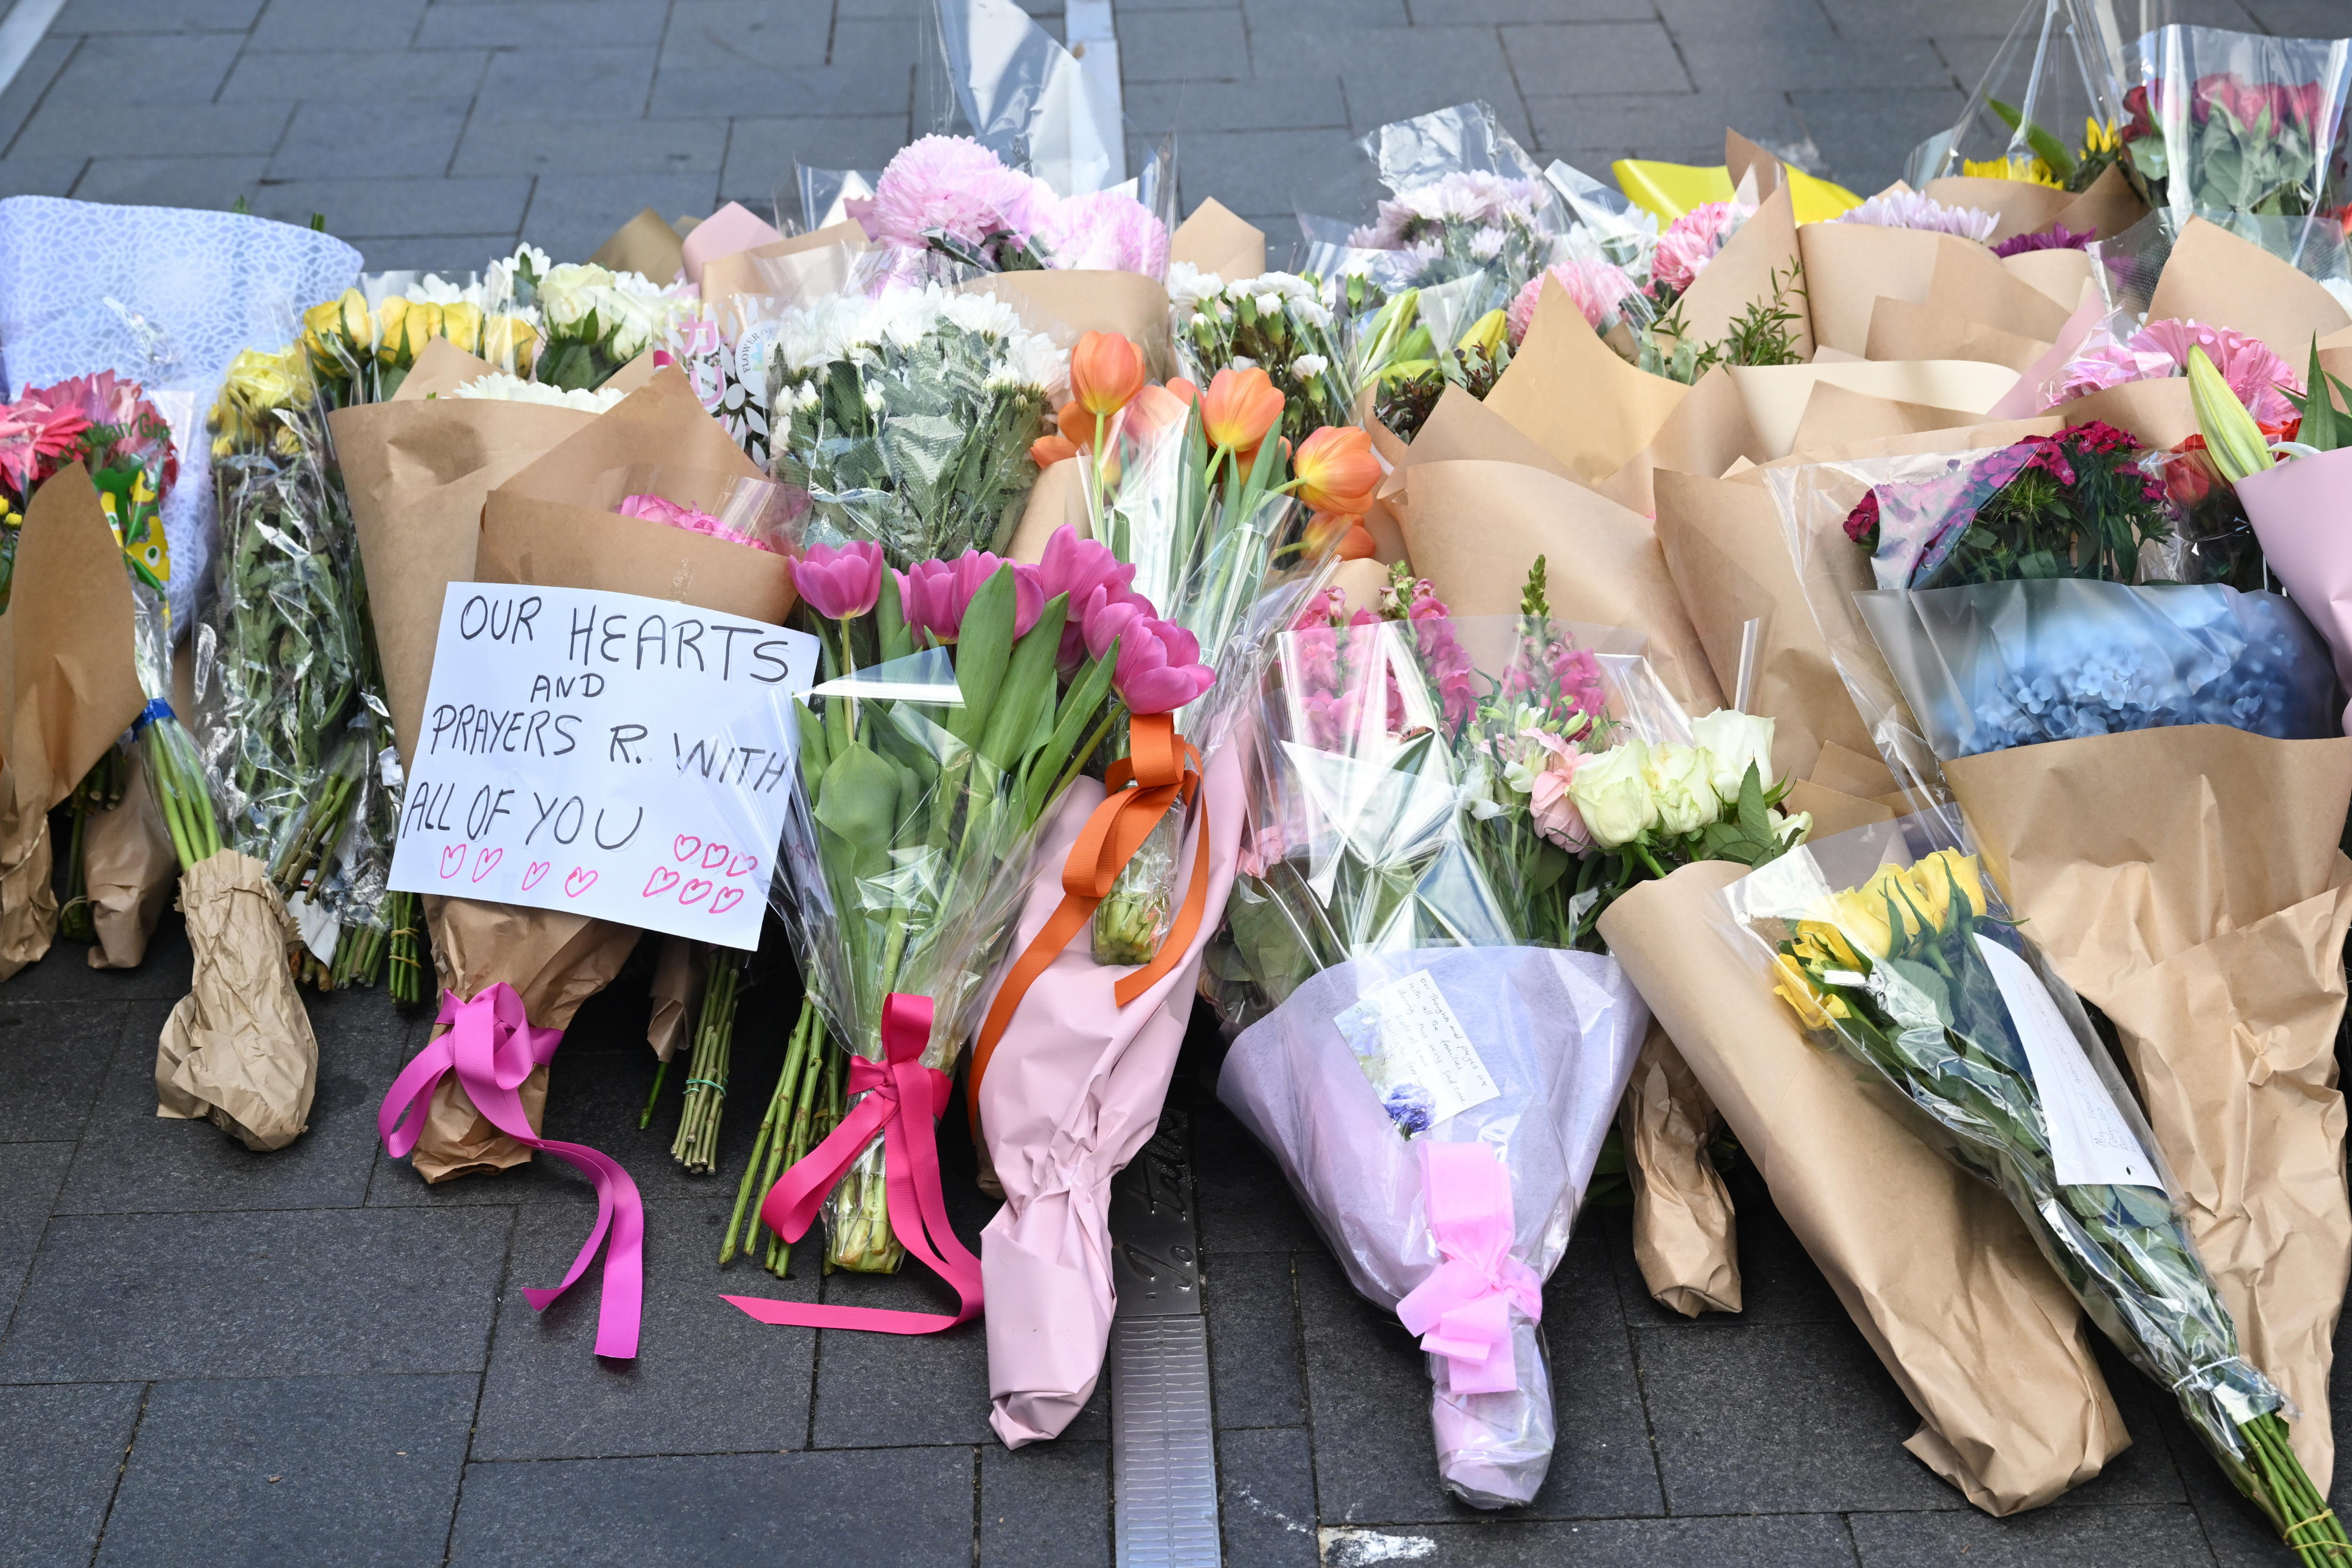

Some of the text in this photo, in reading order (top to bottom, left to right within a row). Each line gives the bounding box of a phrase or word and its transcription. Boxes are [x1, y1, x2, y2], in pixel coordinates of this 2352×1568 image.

[741, 333, 760, 373] FLOWER
[460, 596, 789, 683] OUR HEARTS
[531, 673, 605, 703] AND
[431, 704, 582, 757] PRAYERS
[674, 733, 787, 793] WITH
[403, 781, 643, 850] ALL OF YOU
[1398, 989, 1415, 1015] during
[1409, 982, 1420, 999] with
[1422, 1006, 1433, 1015] all
[1396, 1015, 1410, 1032] Lots
[1421, 978, 1430, 989] Our
[1449, 1025, 1463, 1039] and
[1478, 1075, 1487, 1088] are
